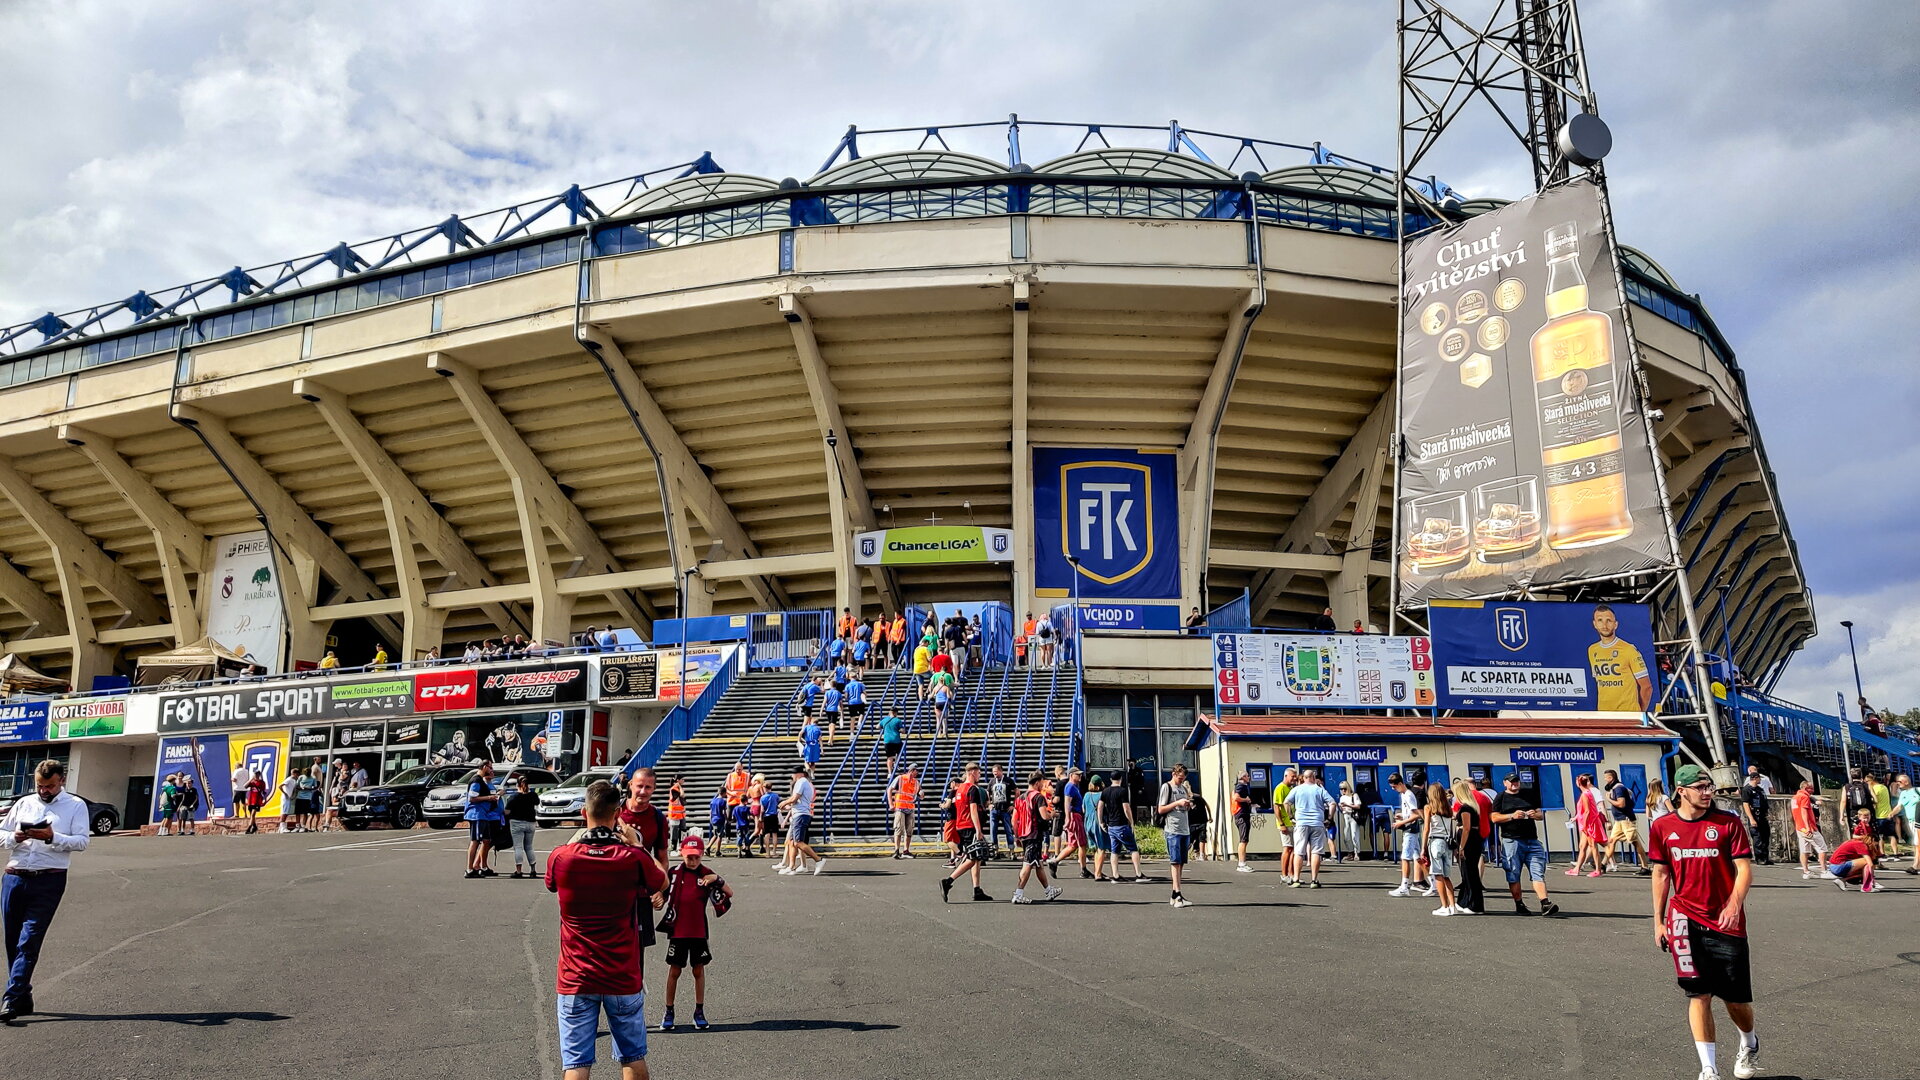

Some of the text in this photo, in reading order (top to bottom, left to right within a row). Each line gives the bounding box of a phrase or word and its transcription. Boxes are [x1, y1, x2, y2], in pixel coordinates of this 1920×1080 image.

[1436, 226, 1502, 267] Chuť
[1415, 241, 1528, 297] vítězství
[1544, 393, 1612, 422] Stará myslivecká
[1557, 410, 1599, 425] SELECTION
[1450, 423, 1476, 436] ŽITNÁ
[1420, 422, 1511, 460] Stará myslivecká
[1079, 482, 1138, 560] FTK
[1083, 608, 1135, 621] VCHOD D
[1502, 614, 1523, 643] FTK
[1224, 635, 1233, 645] A
[1415, 638, 1423, 647] C
[601, 653, 656, 665] TRUHLÁŘSTVÍ
[1225, 652, 1233, 662] B
[1416, 655, 1424, 663] D
[1226, 670, 1234, 679] C
[1418, 672, 1425, 681] G
[1594, 663, 1622, 677] AGC
[483, 669, 580, 688] HOCKEYSHOP
[1461, 671, 1574, 685] AC SPARTA PRAHA
[335, 684, 408, 697] www.fotbal-sport.net
[420, 684, 470, 698] CCM
[504, 685, 556, 700] TEPLICE
[1227, 688, 1235, 697] D
[1420, 690, 1426, 698] E
[1506, 686, 1537, 694] července
[551, 712, 561, 727] P
[298, 734, 325, 744] macron
[353, 730, 378, 739] FANSHOP
[165, 744, 205, 759] FANSHP
[1297, 750, 1380, 761] POKLADNY DOMÁCÍ
[1517, 750, 1597, 760] POKLADNY DOMÁCÍ
[1682, 848, 1719, 858] BETANO
